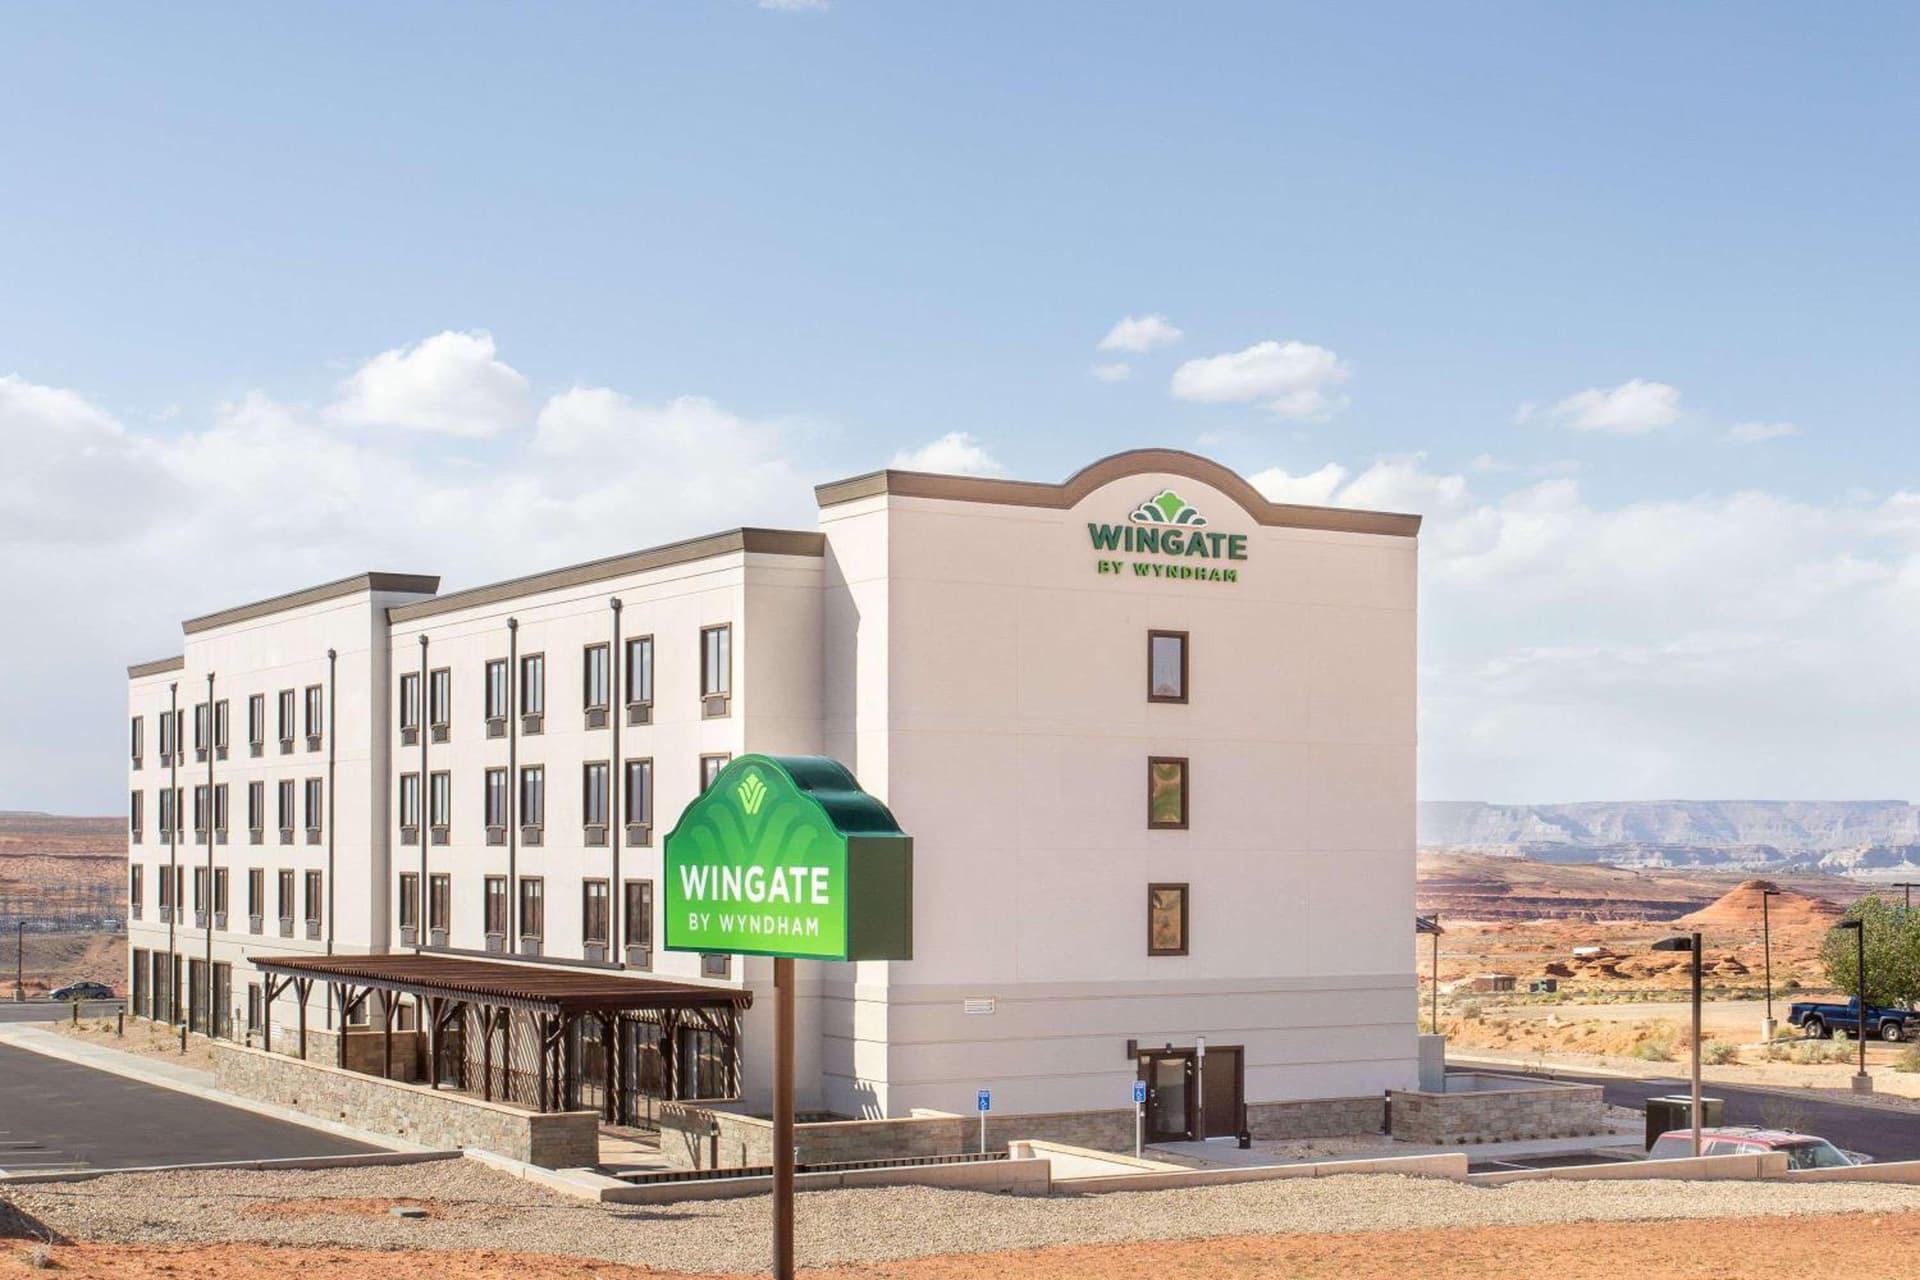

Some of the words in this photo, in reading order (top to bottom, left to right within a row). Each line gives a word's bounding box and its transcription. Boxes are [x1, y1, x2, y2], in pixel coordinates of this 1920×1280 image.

[1088, 523, 1248, 560] WINGATE
[1098, 560, 1123, 574] BY
[1133, 563, 1237, 583] WYNDHAM
[680, 864, 829, 904] WINGATE
[688, 912, 710, 931] BY
[719, 914, 819, 936] WYNDHAM
